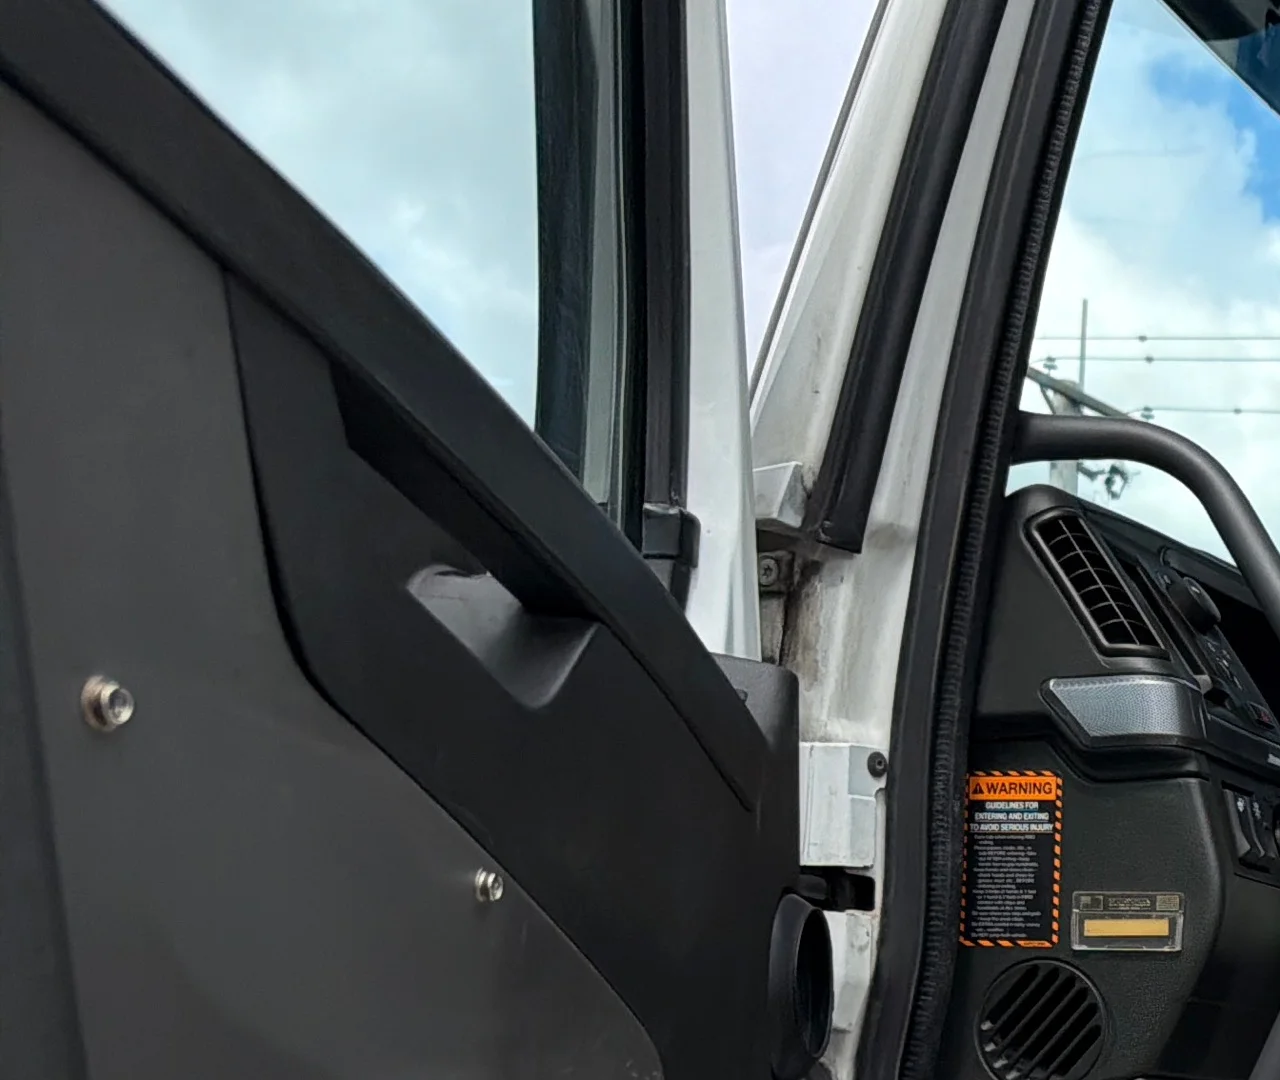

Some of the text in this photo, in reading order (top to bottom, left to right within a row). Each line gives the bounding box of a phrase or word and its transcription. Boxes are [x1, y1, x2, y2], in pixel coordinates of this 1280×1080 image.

[987, 782, 1053, 795] WARNING
[975, 812, 1049, 820] ENTERING AND EXITING
[970, 823, 1053, 831] TO AVOID SERIOUS INJURY
